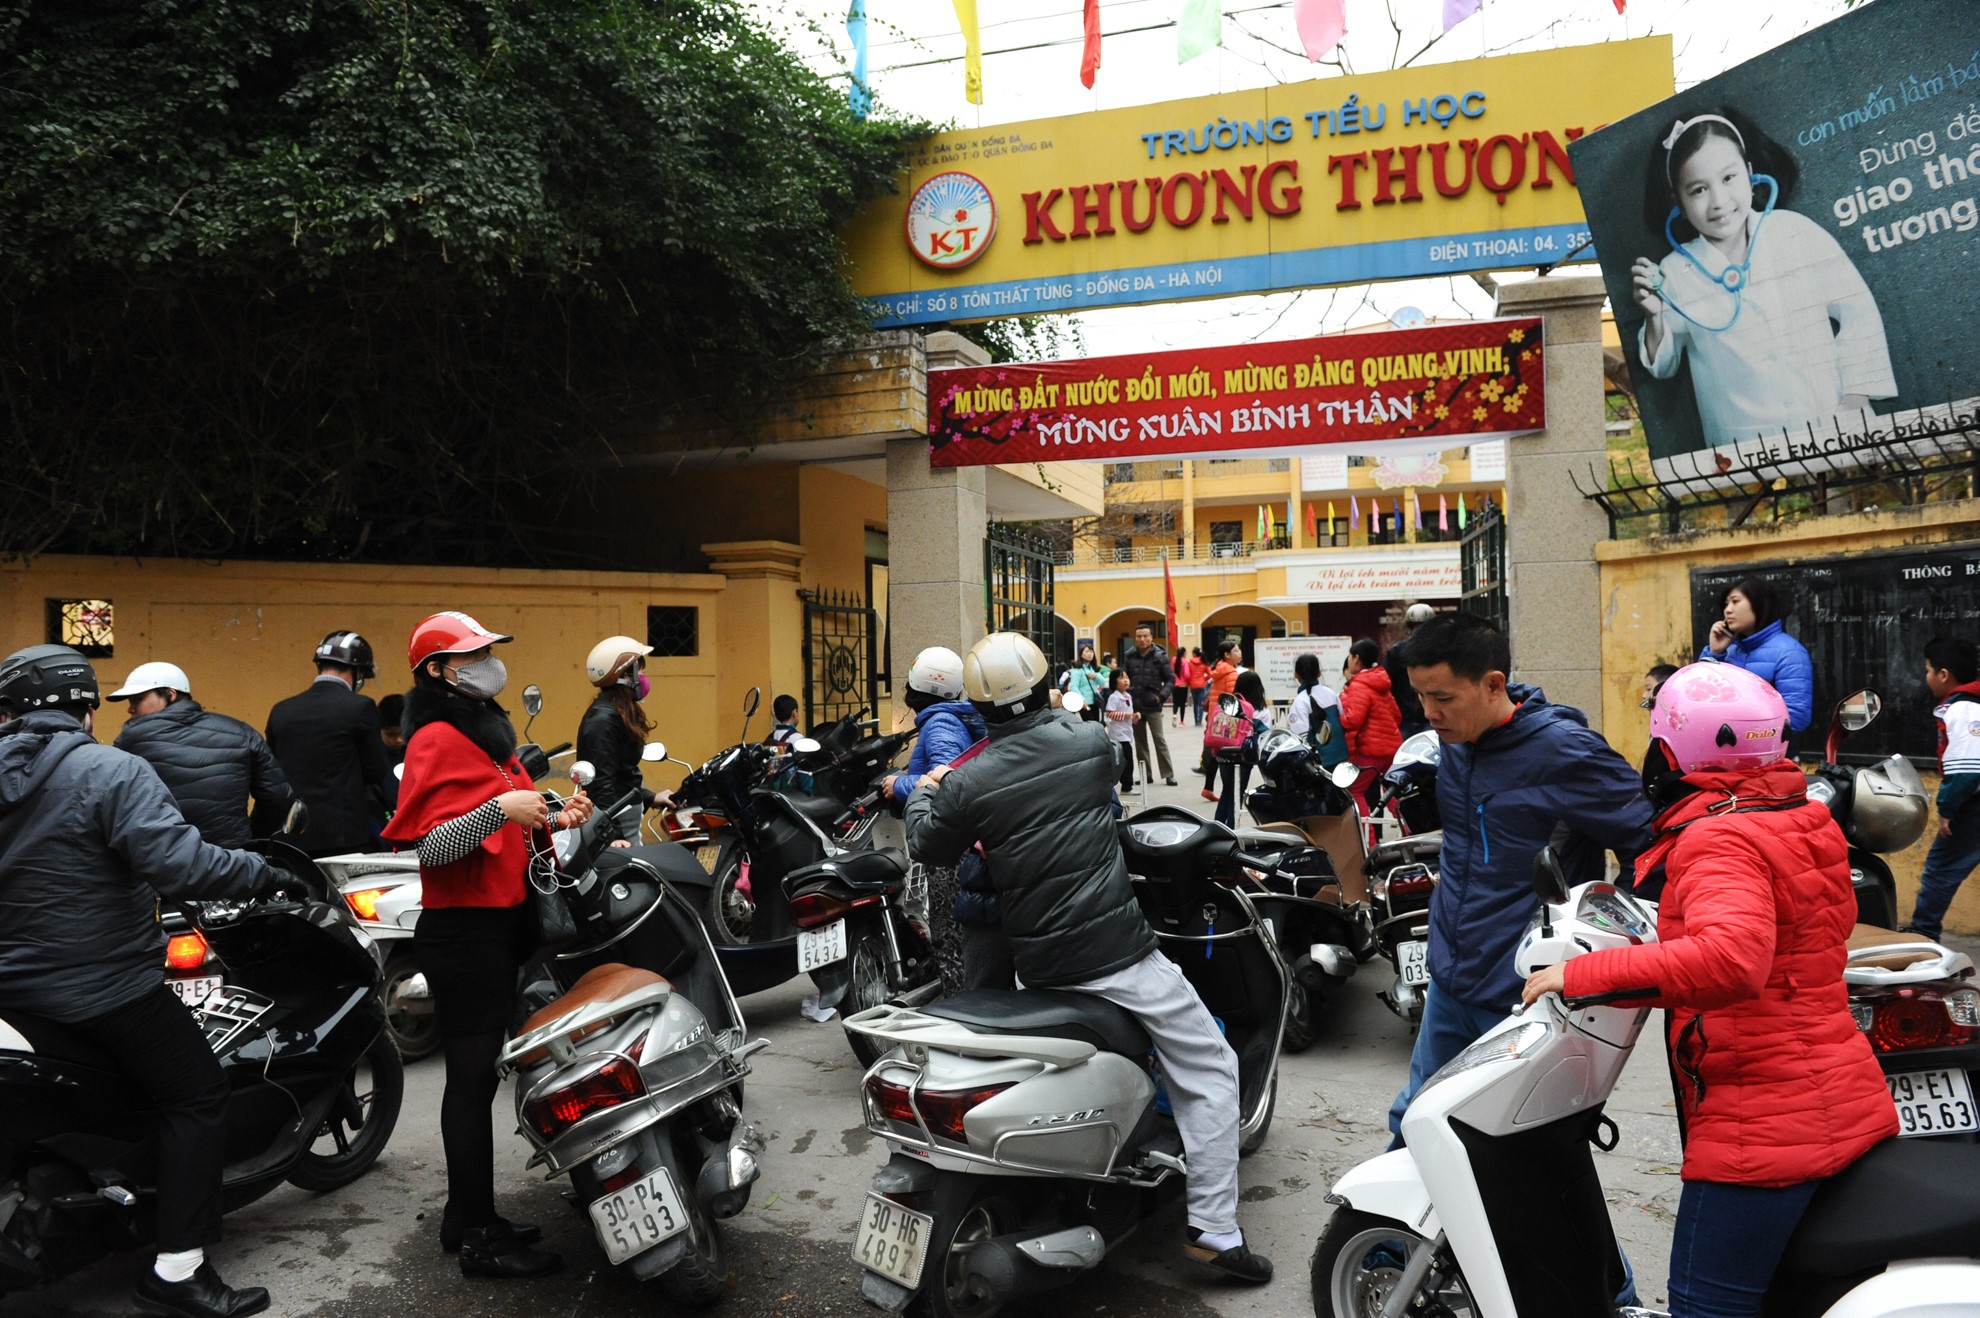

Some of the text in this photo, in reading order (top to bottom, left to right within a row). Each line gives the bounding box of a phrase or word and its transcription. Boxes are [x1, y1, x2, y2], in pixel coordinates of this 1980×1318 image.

[1141, 89, 1486, 158] TRƯỜNG TIỂU HỌC
[1798, 119, 1835, 146] con
[1838, 85, 1895, 131] muốn
[1859, 130, 1937, 174] Đừng
[1021, 159, 1303, 246] KHƯƠNG
[1328, 126, 1584, 211] THƯỢN
[1833, 176, 1913, 227] giao
[929, 226, 978, 256] KT
[1862, 197, 1978, 253] tương
[1430, 241, 1468, 263] ĐIỆN
[1472, 237, 1529, 257] THOẠI:
[927, 292, 947, 312] SỐ
[950, 296, 958, 311] 8
[962, 290, 991, 308] TÔN
[993, 285, 1030, 305] THẤT
[1033, 280, 1073, 302] TÙNG
[1086, 274, 1129, 296] ĐỐNG
[1134, 275, 1155, 292] ĐA
[1168, 270, 1191, 288] HÀ
[1194, 267, 1222, 286] NỘI
[954, 383, 1013, 414] MỪNG
[1018, 374, 1060, 410] ĐẤT
[1066, 374, 1120, 407] NƯỚC
[1126, 364, 1162, 402] ĐỔI
[1169, 365, 1217, 398] MỚI,
[1224, 361, 1288, 394] MỪNG
[1294, 354, 1355, 388] ĐẢNG
[1361, 351, 1438, 387] QUANG
[1036, 391, 1413, 446] MỪNG XUÂN BÍNH THÂN
[1902, 564, 1953, 580] THÔNG
[805, 942, 838, 969] 5432
[1901, 1100, 1972, 1132] 95.63
[601, 1177, 663, 1227] 30-P4
[869, 1201, 920, 1246] 30-H6
[612, 1205, 675, 1254] 5193
